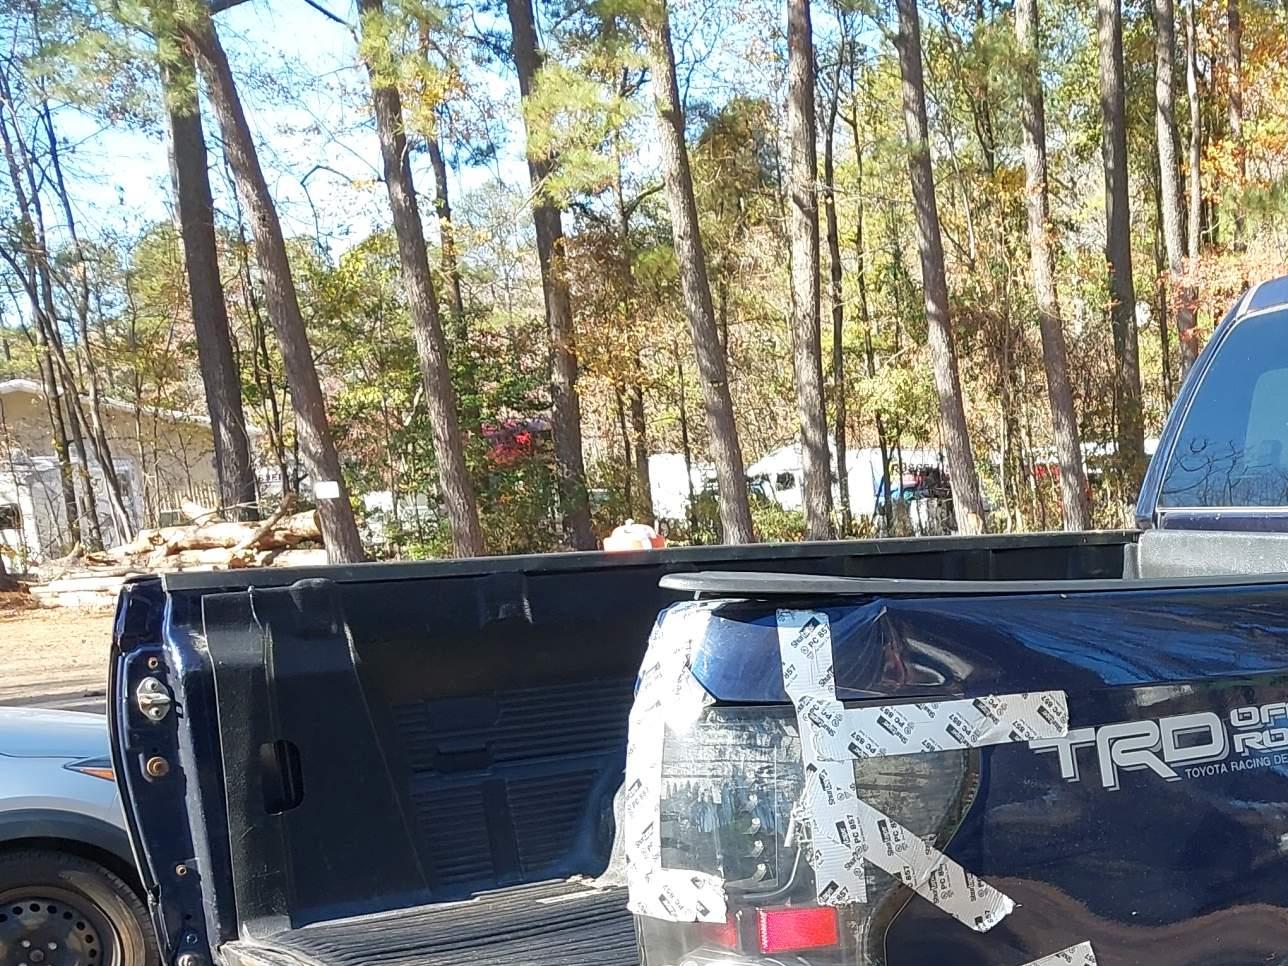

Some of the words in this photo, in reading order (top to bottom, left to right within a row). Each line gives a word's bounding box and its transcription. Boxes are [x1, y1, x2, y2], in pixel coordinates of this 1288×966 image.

[807, 636, 819, 648] PC
[986, 697, 999, 709] PC
[1039, 694, 1054, 707] 857
[1051, 705, 1062, 716] PC
[893, 715, 905, 727] PC
[948, 713, 962, 726] 857
[960, 724, 972, 735] PC
[1010, 719, 1025, 733] 857
[850, 730, 865, 744] 857
[864, 742, 876, 753] PC
[1029, 712, 1230, 791] TRD
[1185, 763, 1228, 779] TOYOTA
[1231, 756, 1271, 773] RACING
[846, 813, 856, 830] 857
[888, 818, 896, 828] 85
[853, 831, 861, 843] PC
[892, 830, 900, 842] PC
[903, 866, 912, 882] 857
[938, 878, 946, 889] PC
[836, 886, 849, 902] 857
